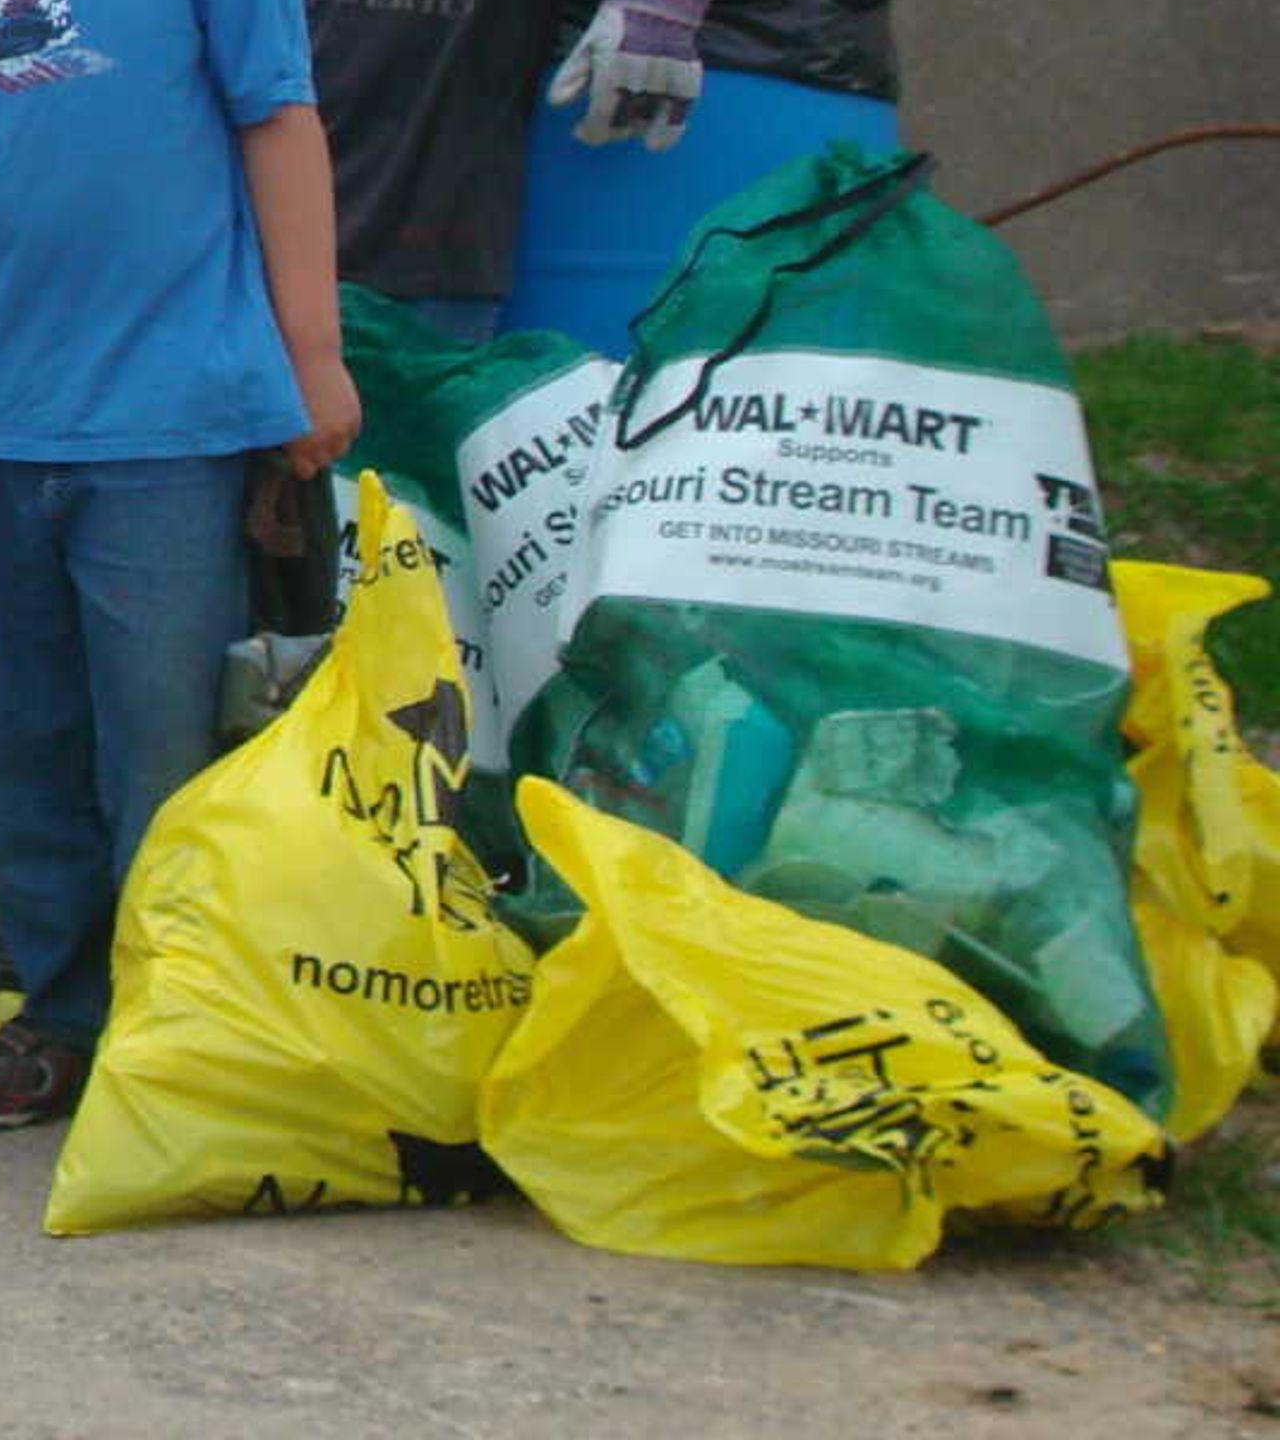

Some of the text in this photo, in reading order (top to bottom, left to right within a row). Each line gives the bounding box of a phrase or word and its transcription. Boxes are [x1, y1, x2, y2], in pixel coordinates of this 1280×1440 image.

[777, 438, 894, 468] Supports
[719, 467, 891, 517] Stream
[907, 484, 1032, 542] Team
[658, 521, 704, 539] GET
[709, 523, 763, 544] INTO
[767, 528, 881, 556] MISSOURI
